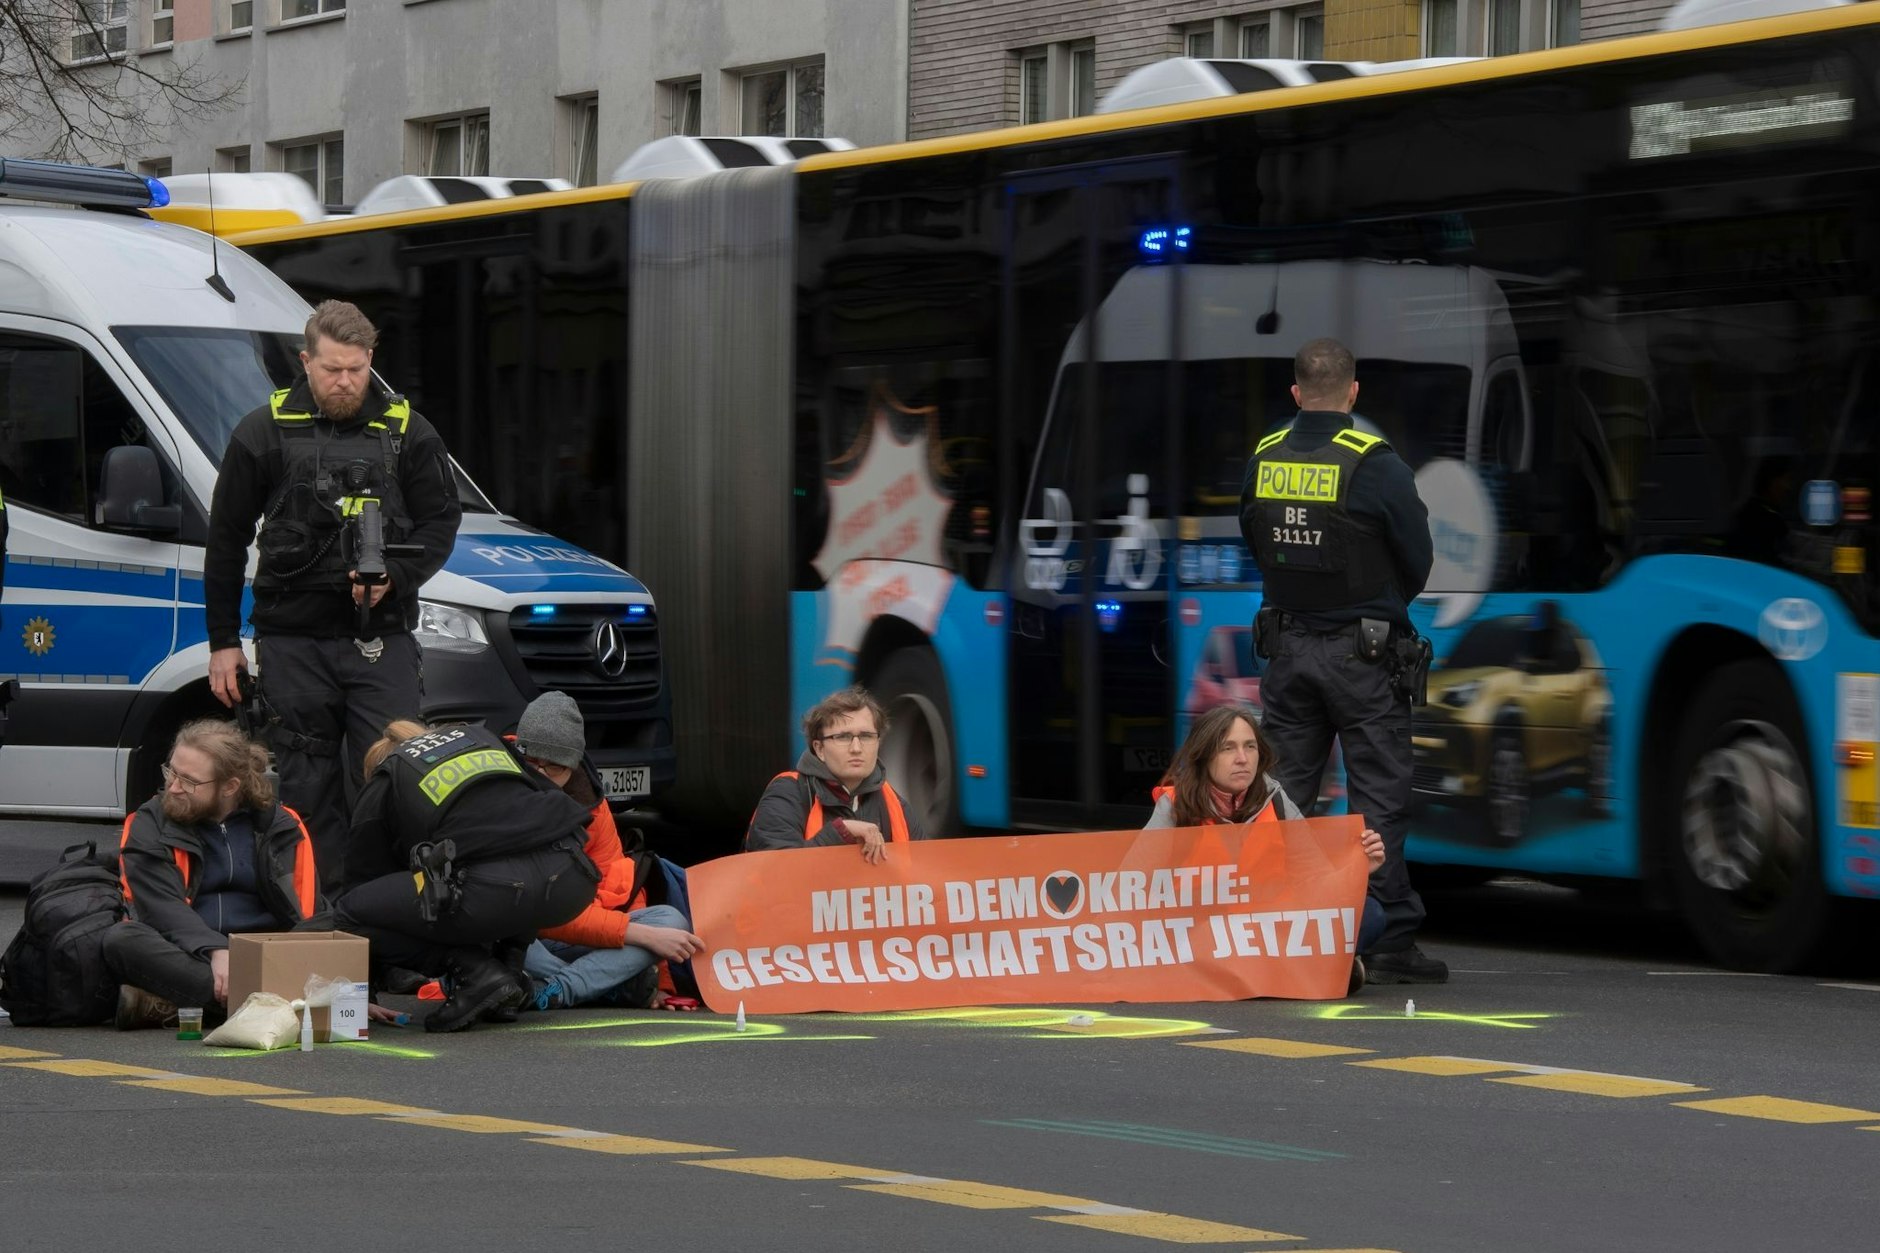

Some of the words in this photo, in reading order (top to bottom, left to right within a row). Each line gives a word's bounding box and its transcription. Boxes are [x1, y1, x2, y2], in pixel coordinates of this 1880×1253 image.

[1259, 466, 1336, 497] POLIZEI
[1285, 506, 1307, 526] BE
[1272, 527, 1322, 546] 31117
[405, 729, 466, 758] 31115
[612, 770, 644, 793] 31857
[811, 884, 936, 933] MEHR
[712, 917, 1194, 991] GESELLSCHAFTSRAT
[1209, 908, 1355, 959] JETZT!
[339, 1009, 355, 1018] 100
